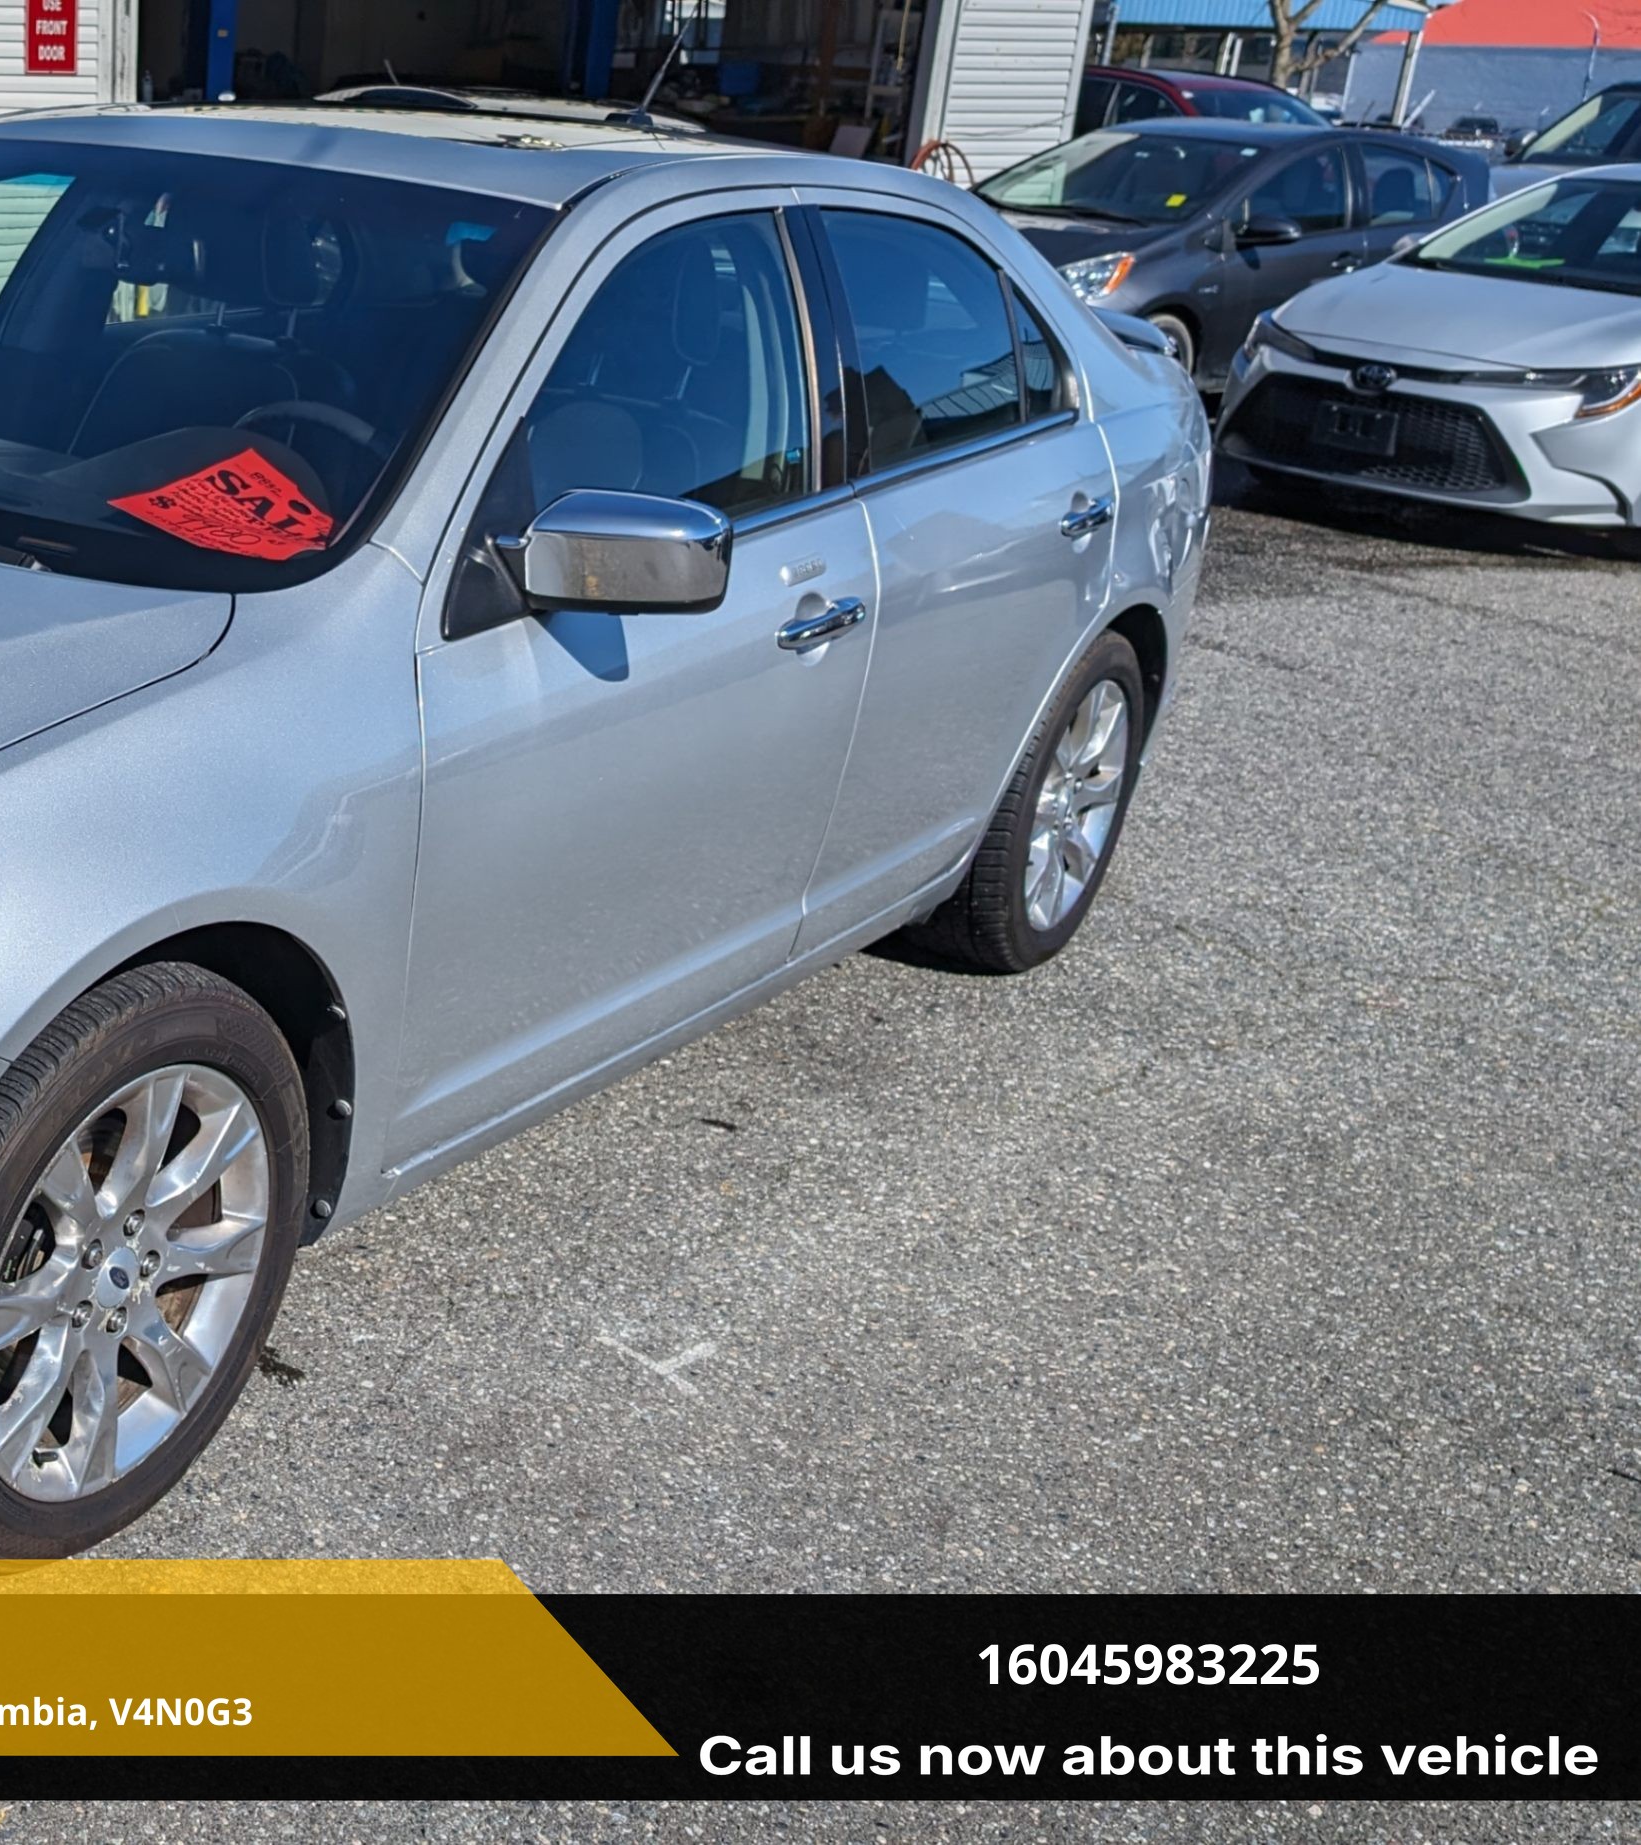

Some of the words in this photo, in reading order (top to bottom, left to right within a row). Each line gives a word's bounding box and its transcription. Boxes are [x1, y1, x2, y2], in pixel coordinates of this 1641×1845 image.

[36, 19, 68, 35] FRONT
[38, 45, 66, 61] DOOR
[204, 469, 327, 541] SAL
